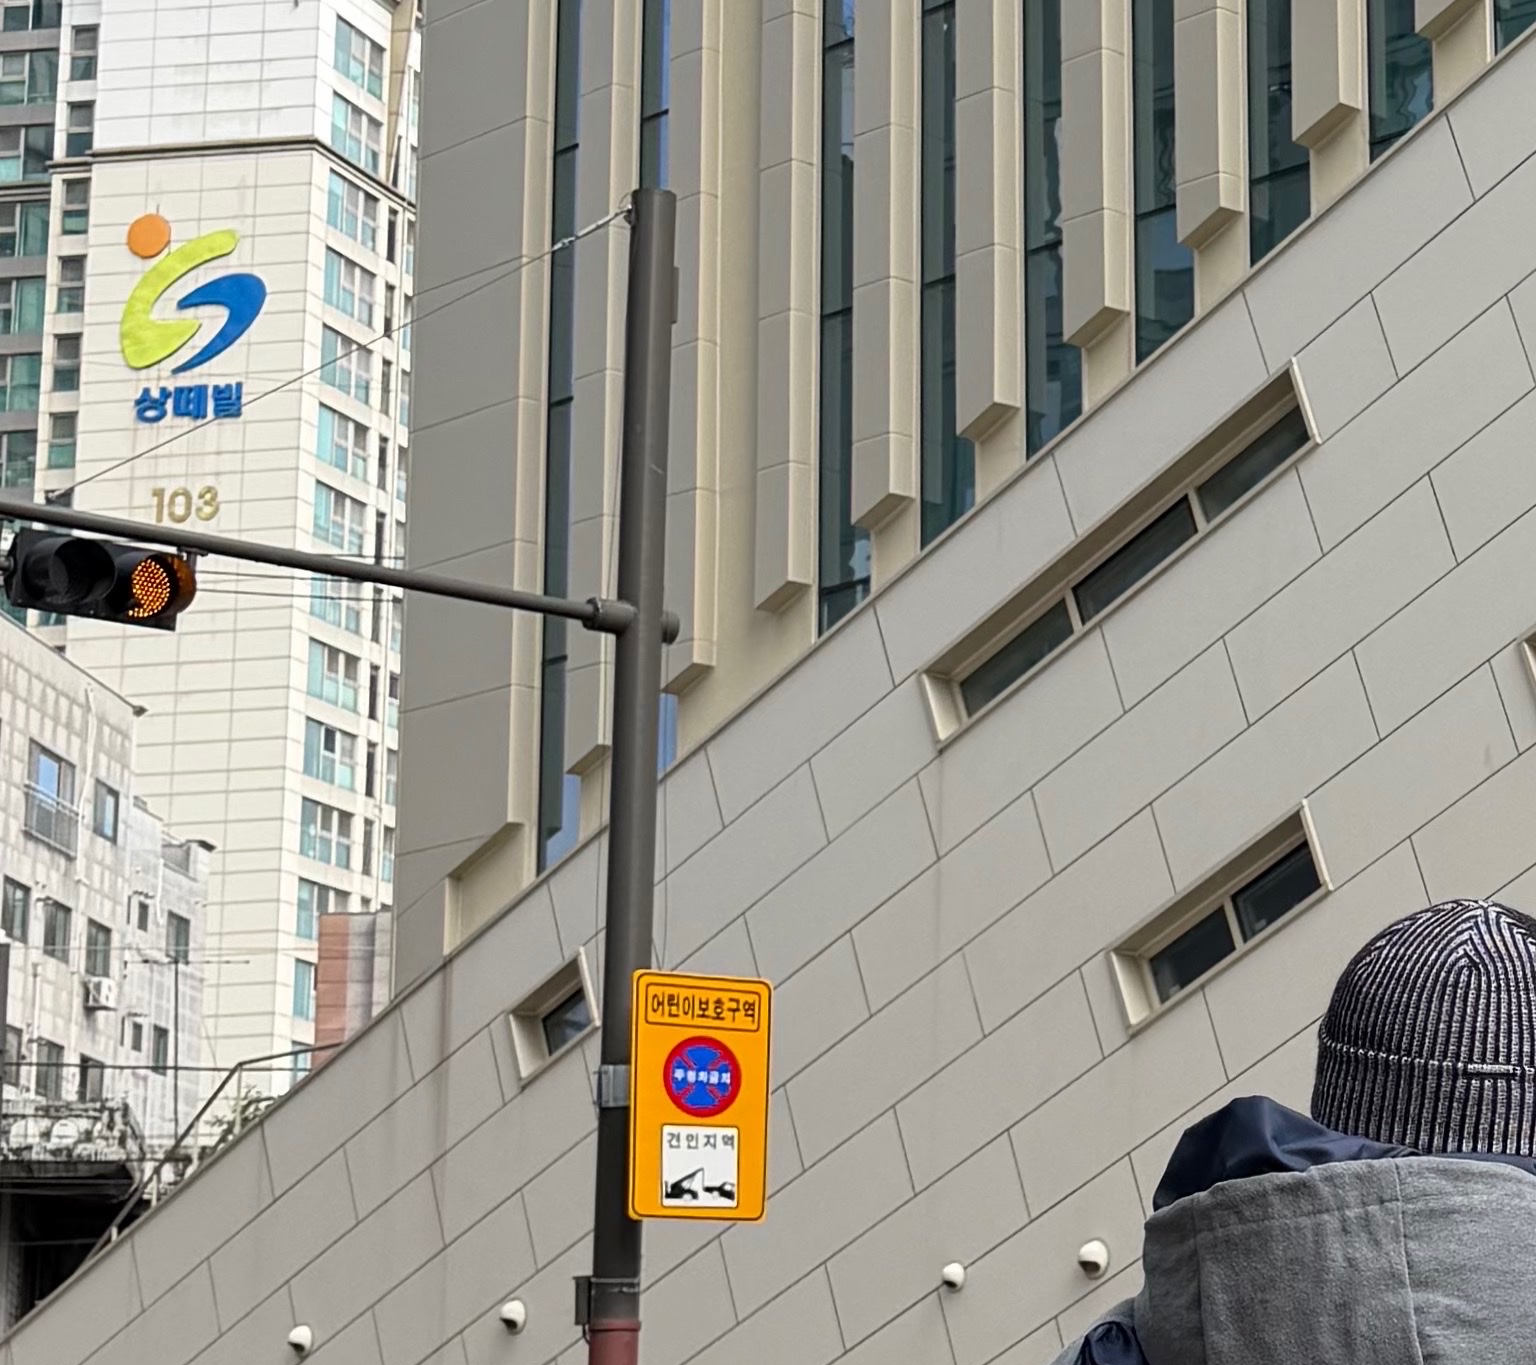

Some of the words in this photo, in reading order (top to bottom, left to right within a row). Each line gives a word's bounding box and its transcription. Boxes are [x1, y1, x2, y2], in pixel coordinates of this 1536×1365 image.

[134, 381, 243, 424] 상떼빌
[151, 485, 220, 524] 103
[651, 991, 756, 1024] 어린이보호구역
[666, 1131, 735, 1151] 견인지역
